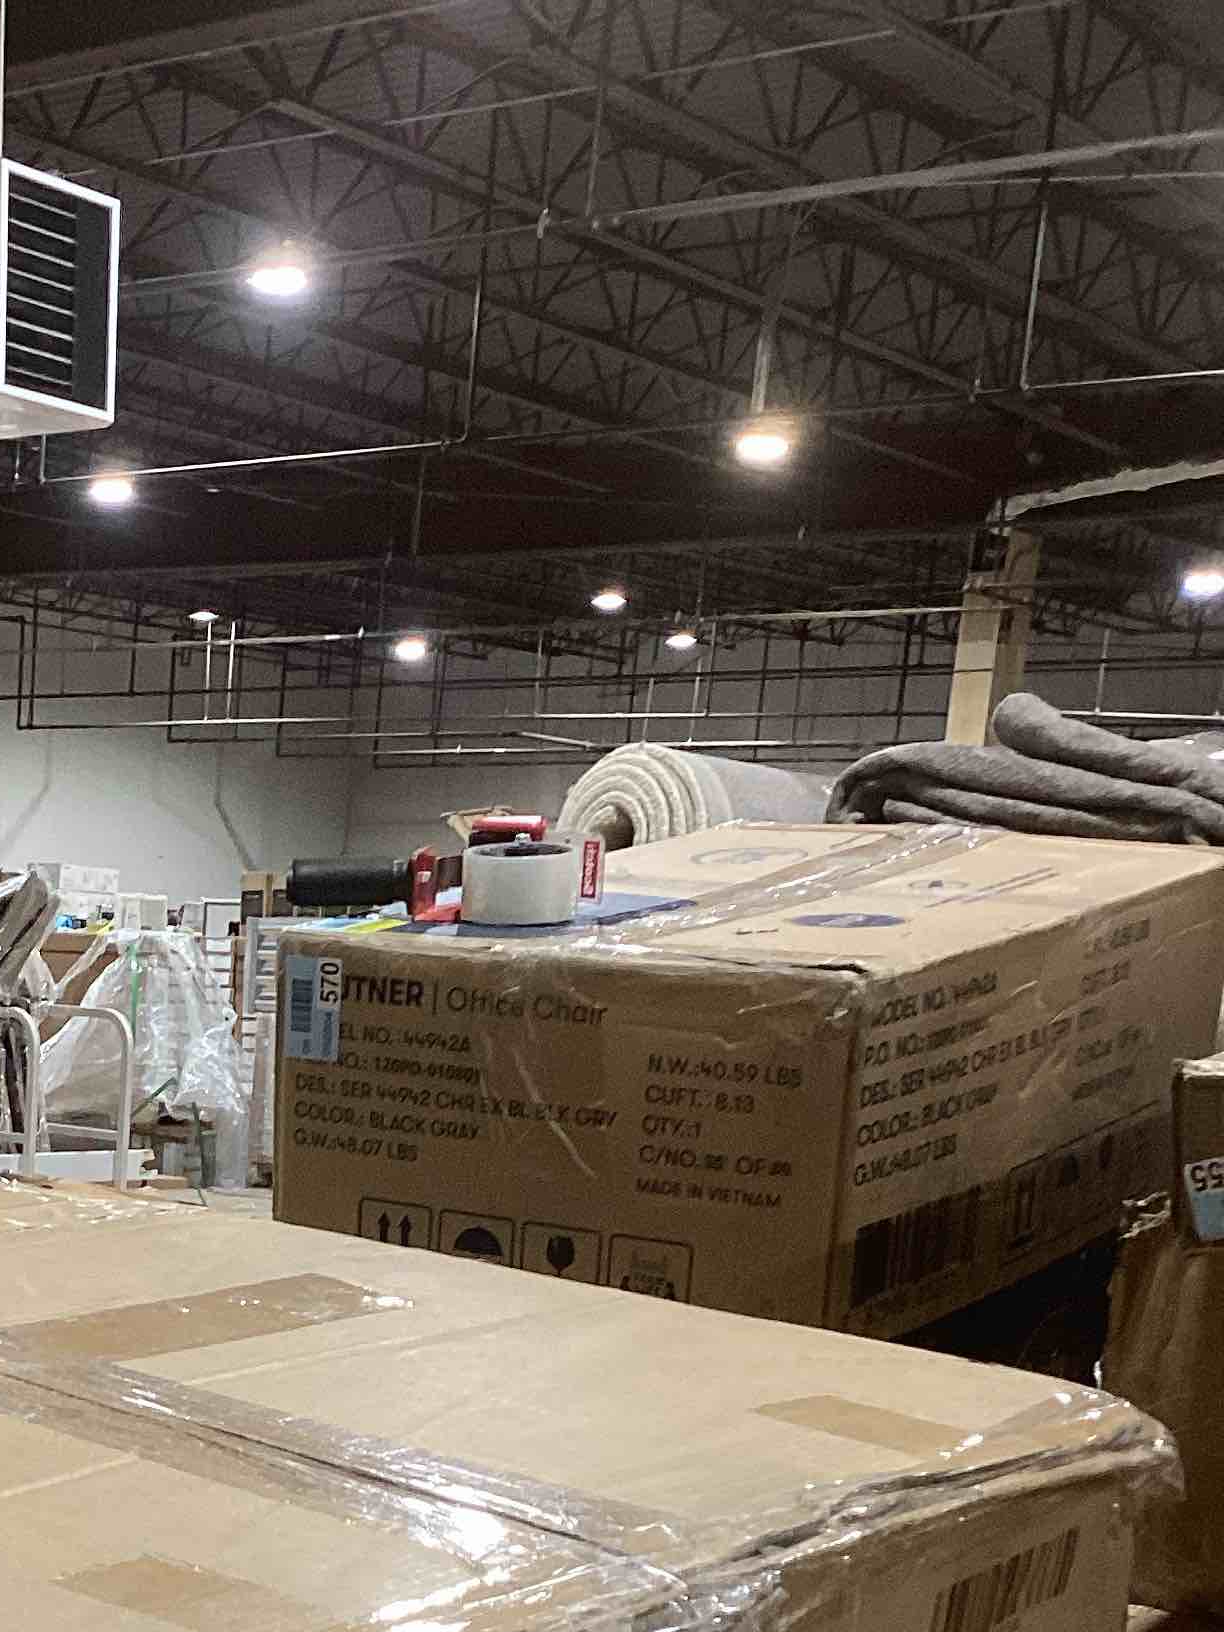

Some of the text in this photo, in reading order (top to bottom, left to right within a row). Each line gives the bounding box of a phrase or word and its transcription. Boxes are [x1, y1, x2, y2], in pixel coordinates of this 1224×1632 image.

[319, 962, 340, 1003] 570
[447, 985, 524, 1018] Office
[532, 992, 608, 1026] Chair
[764, 1063, 804, 1089] LBS
[369, 1109, 426, 1136] BLACK
[430, 1119, 479, 1141] GRAY
[634, 1176, 784, 1209] MADE IN VIETNAM
